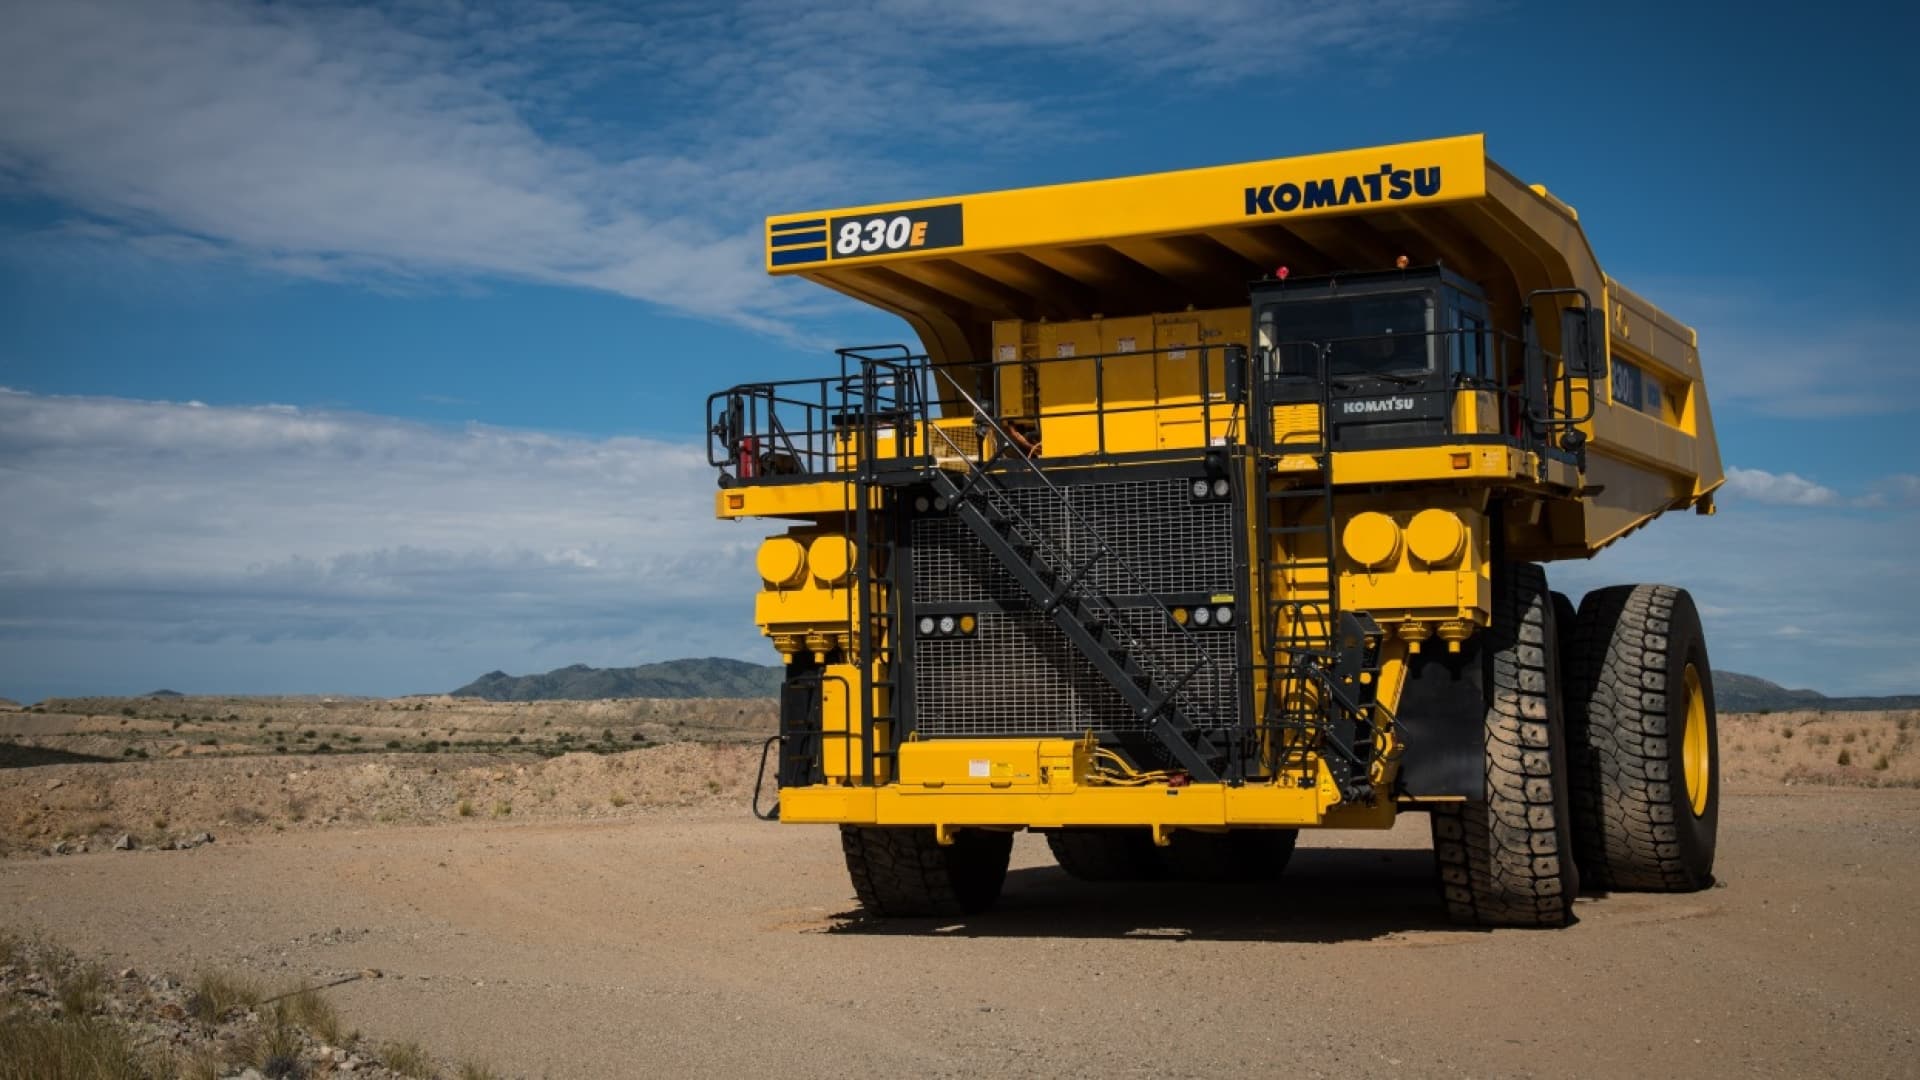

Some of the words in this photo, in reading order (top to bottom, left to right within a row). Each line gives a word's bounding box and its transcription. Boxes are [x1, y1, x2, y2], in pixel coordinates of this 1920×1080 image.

[1245, 164, 1440, 215] KOMATSU
[836, 215, 928, 254] 830E
[1343, 396, 1414, 413] KOMATSU
